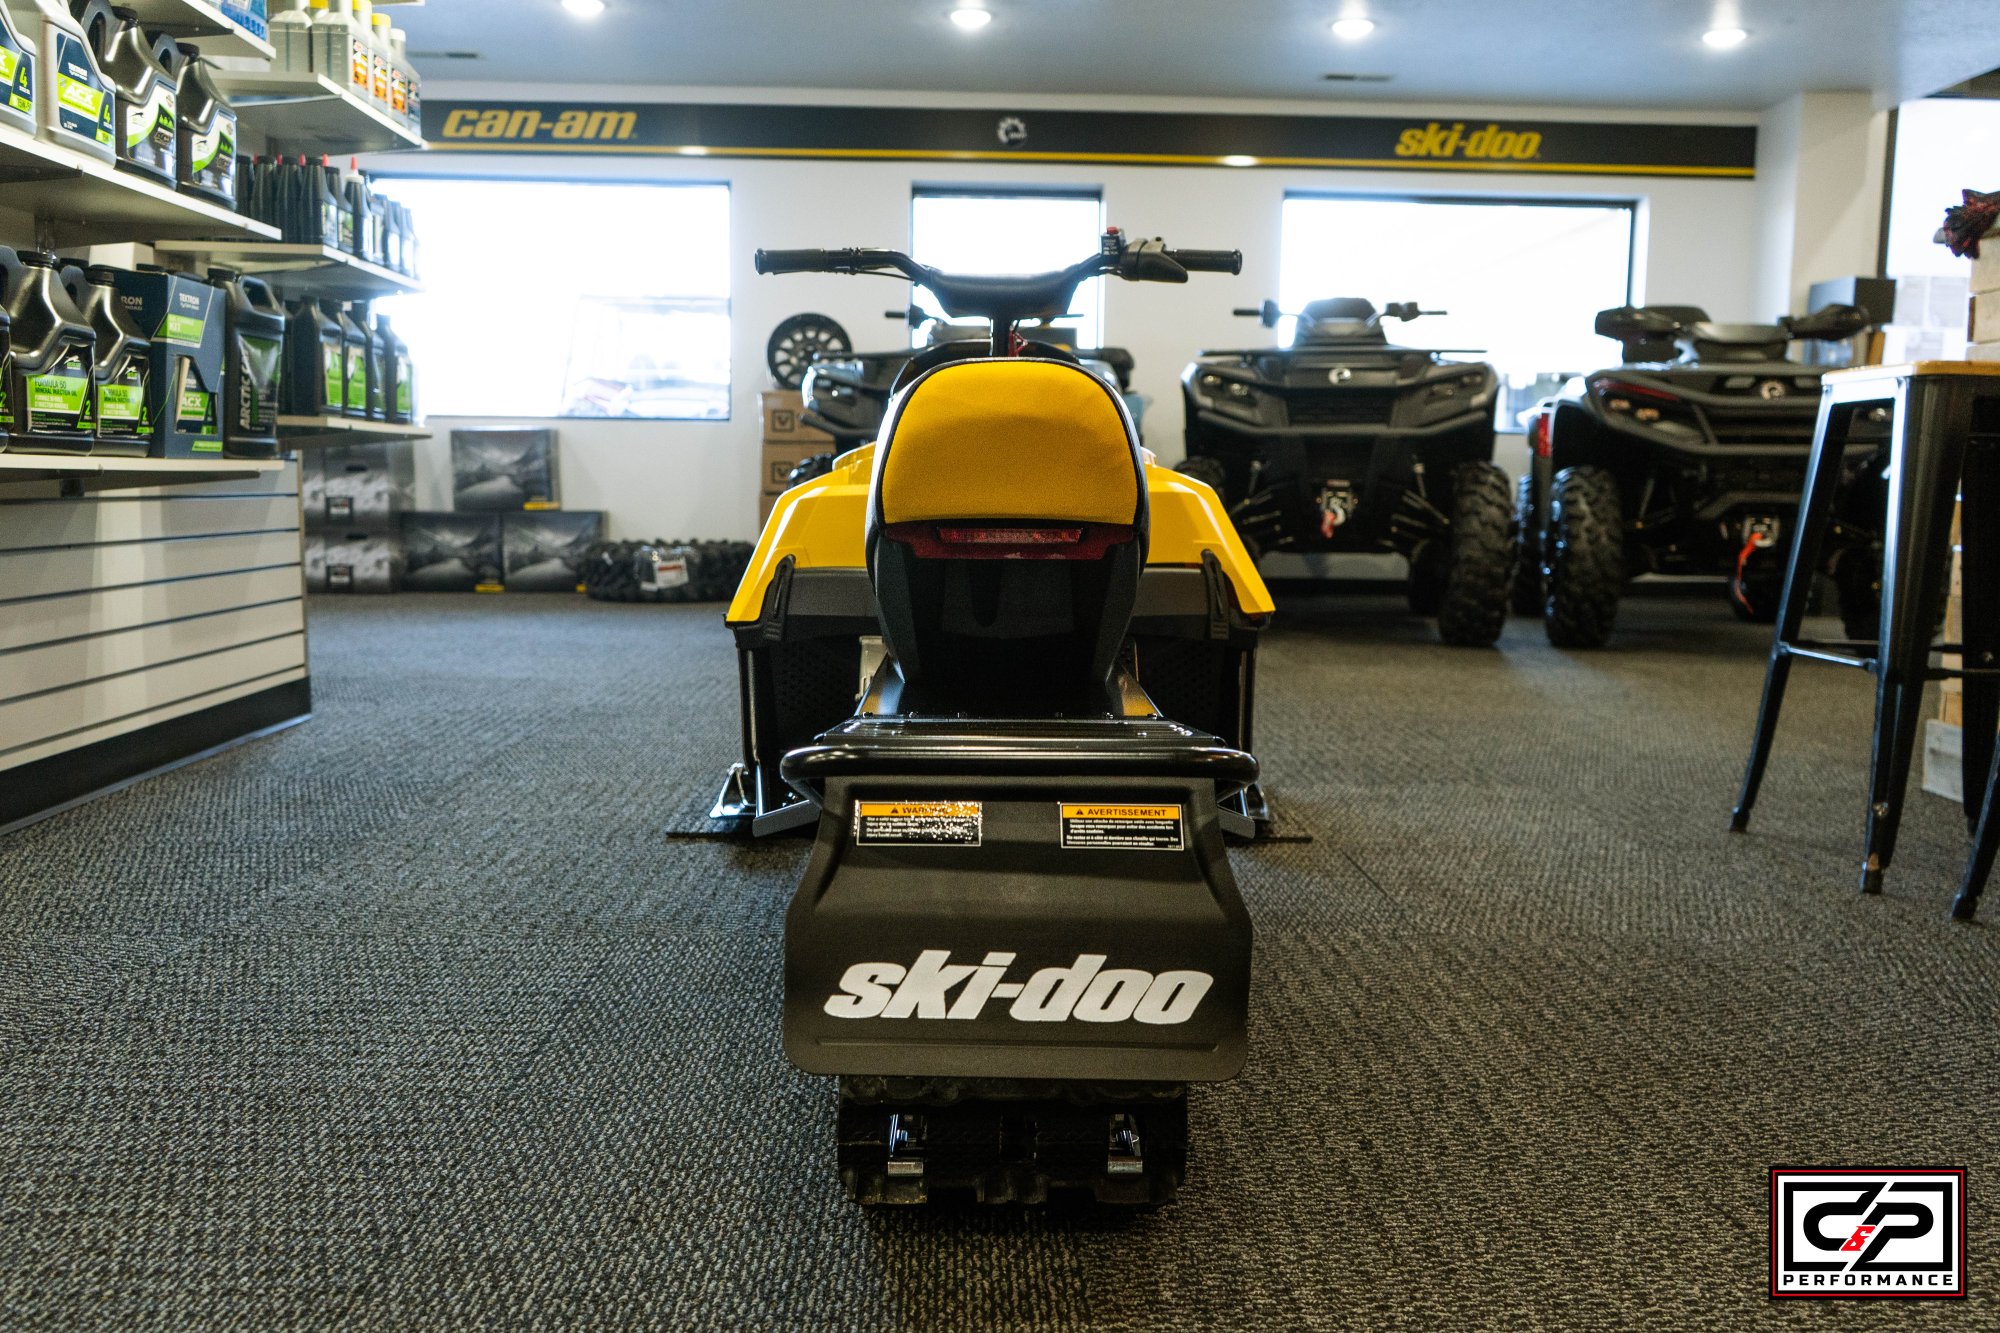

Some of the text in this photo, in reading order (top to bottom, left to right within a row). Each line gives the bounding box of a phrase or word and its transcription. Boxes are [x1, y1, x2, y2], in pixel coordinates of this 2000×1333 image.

[442, 109, 638, 139] can-am
[1394, 122, 1542, 160] ski-doo
[1087, 808, 1167, 816] AVERTISSEMENT
[823, 949, 1214, 1024] ski-doo
